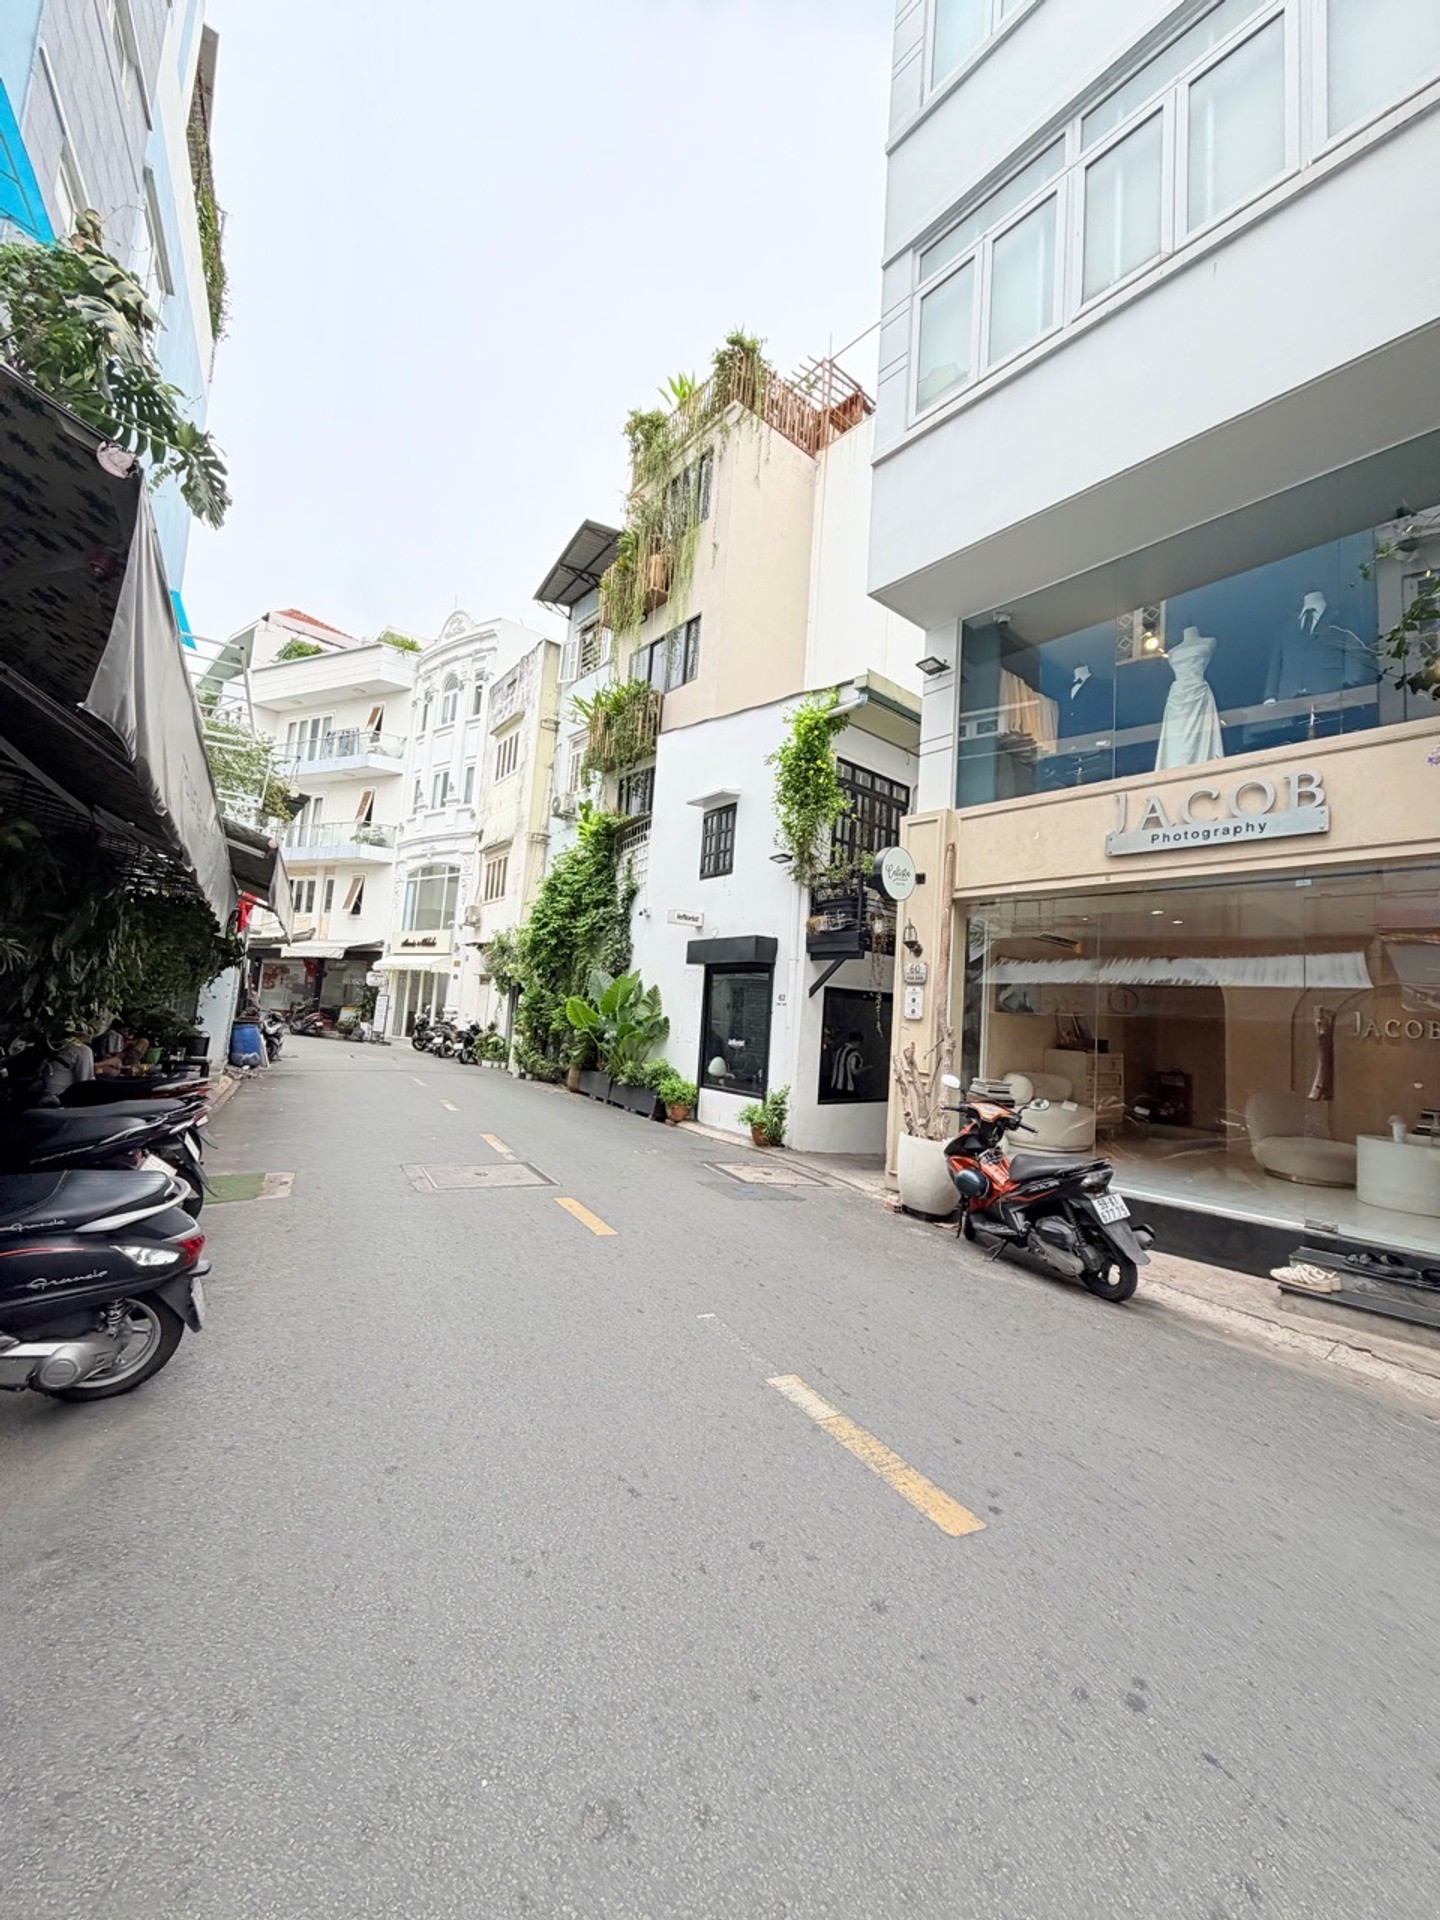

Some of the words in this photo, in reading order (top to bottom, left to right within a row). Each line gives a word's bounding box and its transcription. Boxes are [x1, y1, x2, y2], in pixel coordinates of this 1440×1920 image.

[1115, 770, 1326, 834] JACOB
[1151, 821, 1268, 844] Photography
[1352, 1010, 1440, 1040] JACOB
